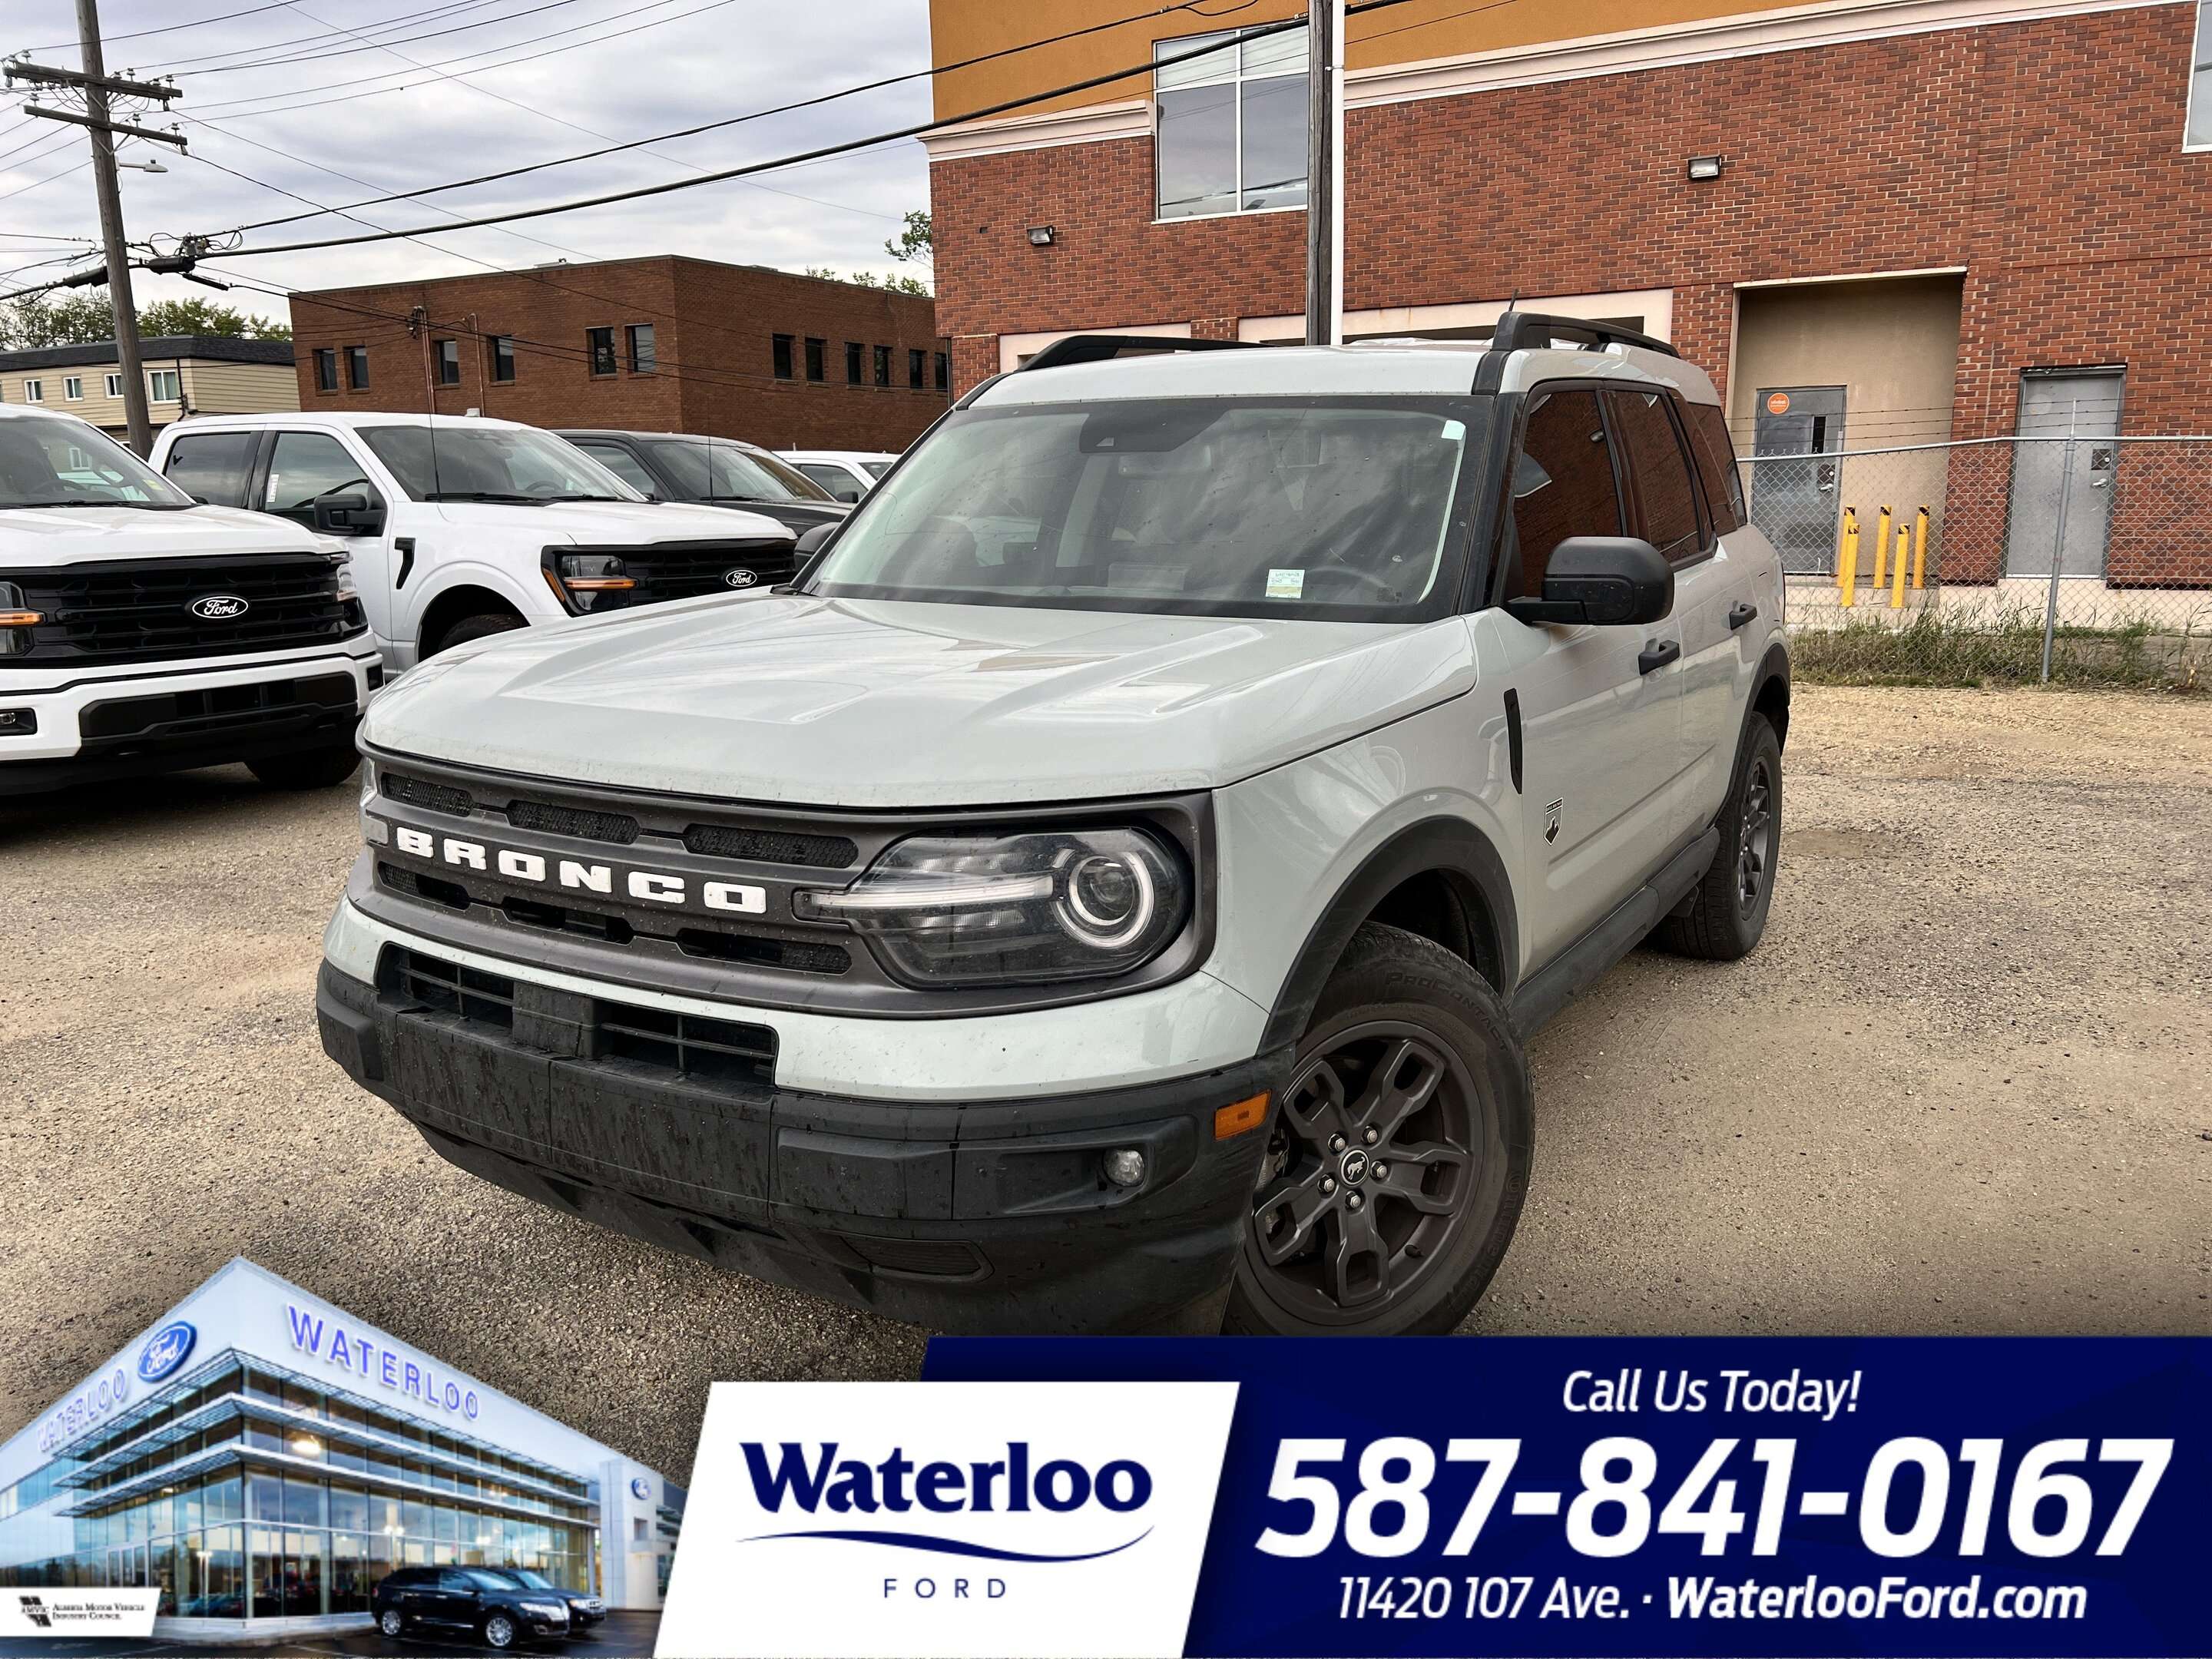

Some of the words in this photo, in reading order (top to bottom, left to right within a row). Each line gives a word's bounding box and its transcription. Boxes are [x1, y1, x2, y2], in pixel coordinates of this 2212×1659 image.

[731, 571, 752, 584] Ford
[204, 599, 238, 615] Ford
[396, 826, 767, 914] BRONCO
